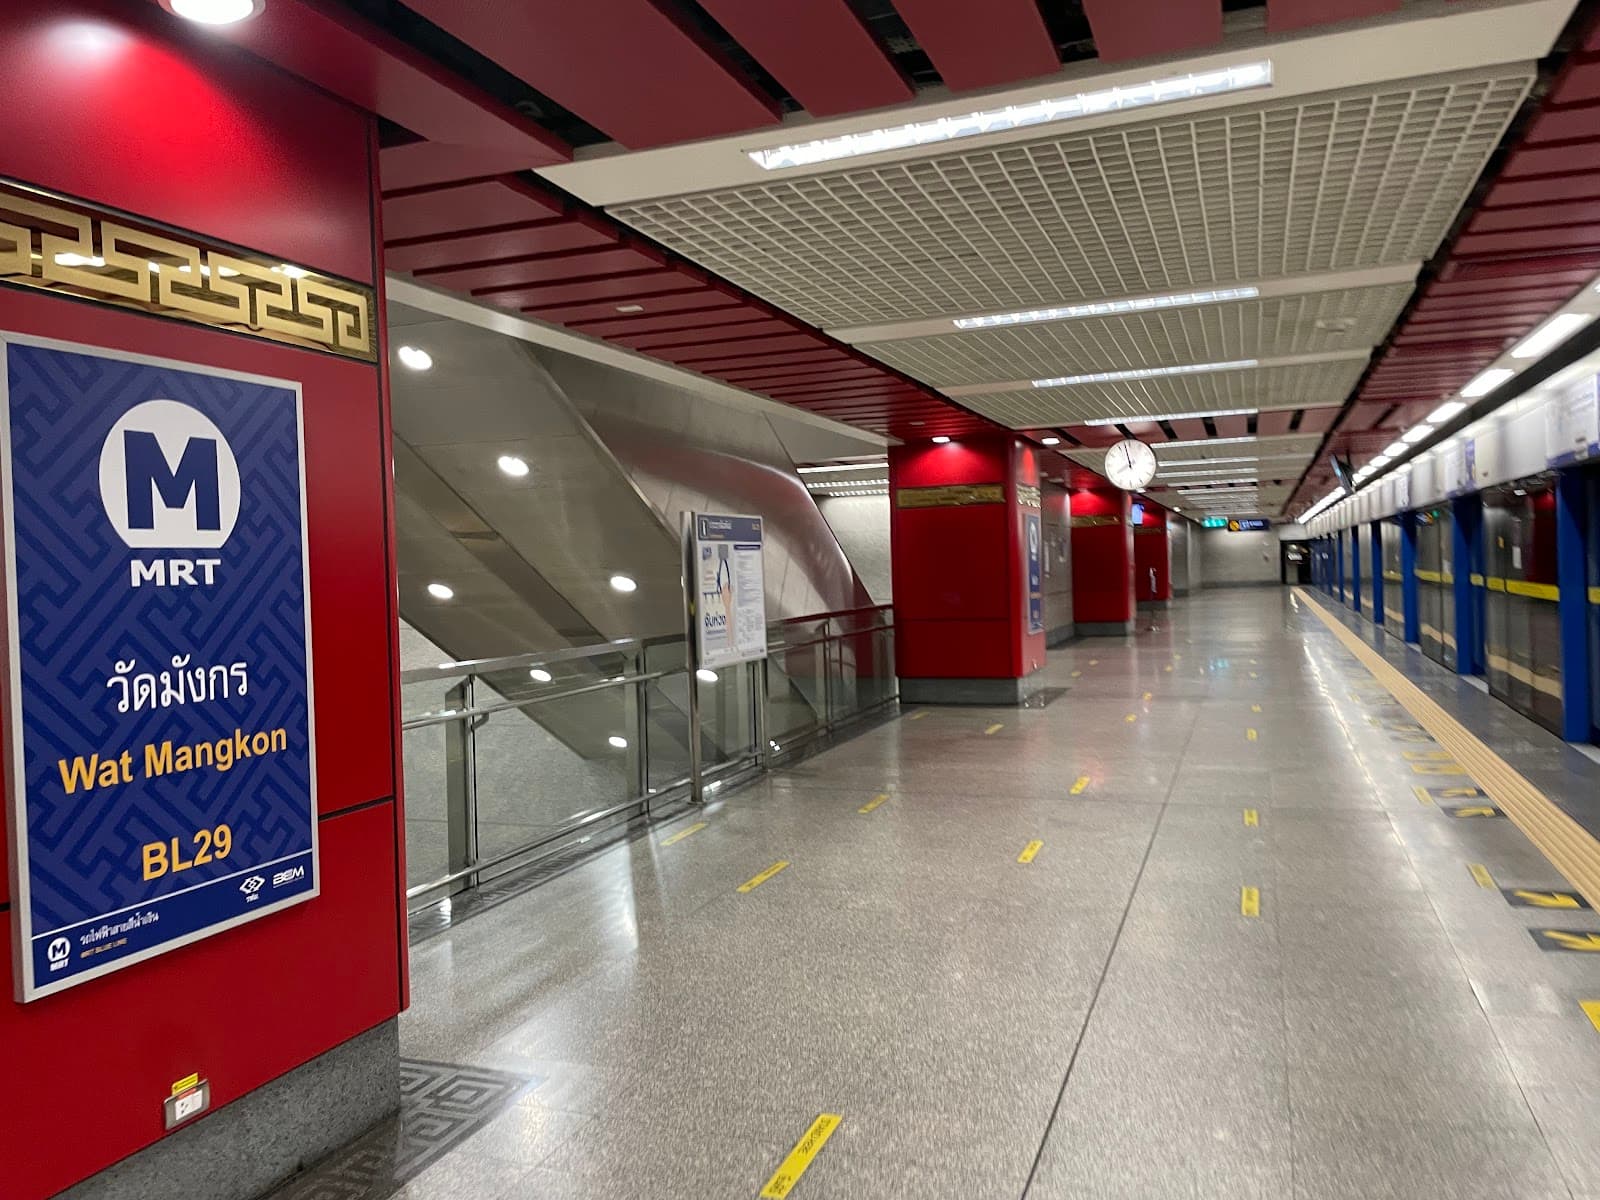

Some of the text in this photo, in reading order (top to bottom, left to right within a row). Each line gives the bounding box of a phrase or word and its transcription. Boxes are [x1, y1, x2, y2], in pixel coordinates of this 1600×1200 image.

[124, 429, 221, 531] M
[130, 559, 221, 587] MRT
[106, 653, 248, 713] วัดมังกร
[57, 728, 287, 794] Wat Mangkon
[142, 823, 232, 881] BL29
[272, 865, 305, 885] BEM
[51, 941, 67, 959] M
